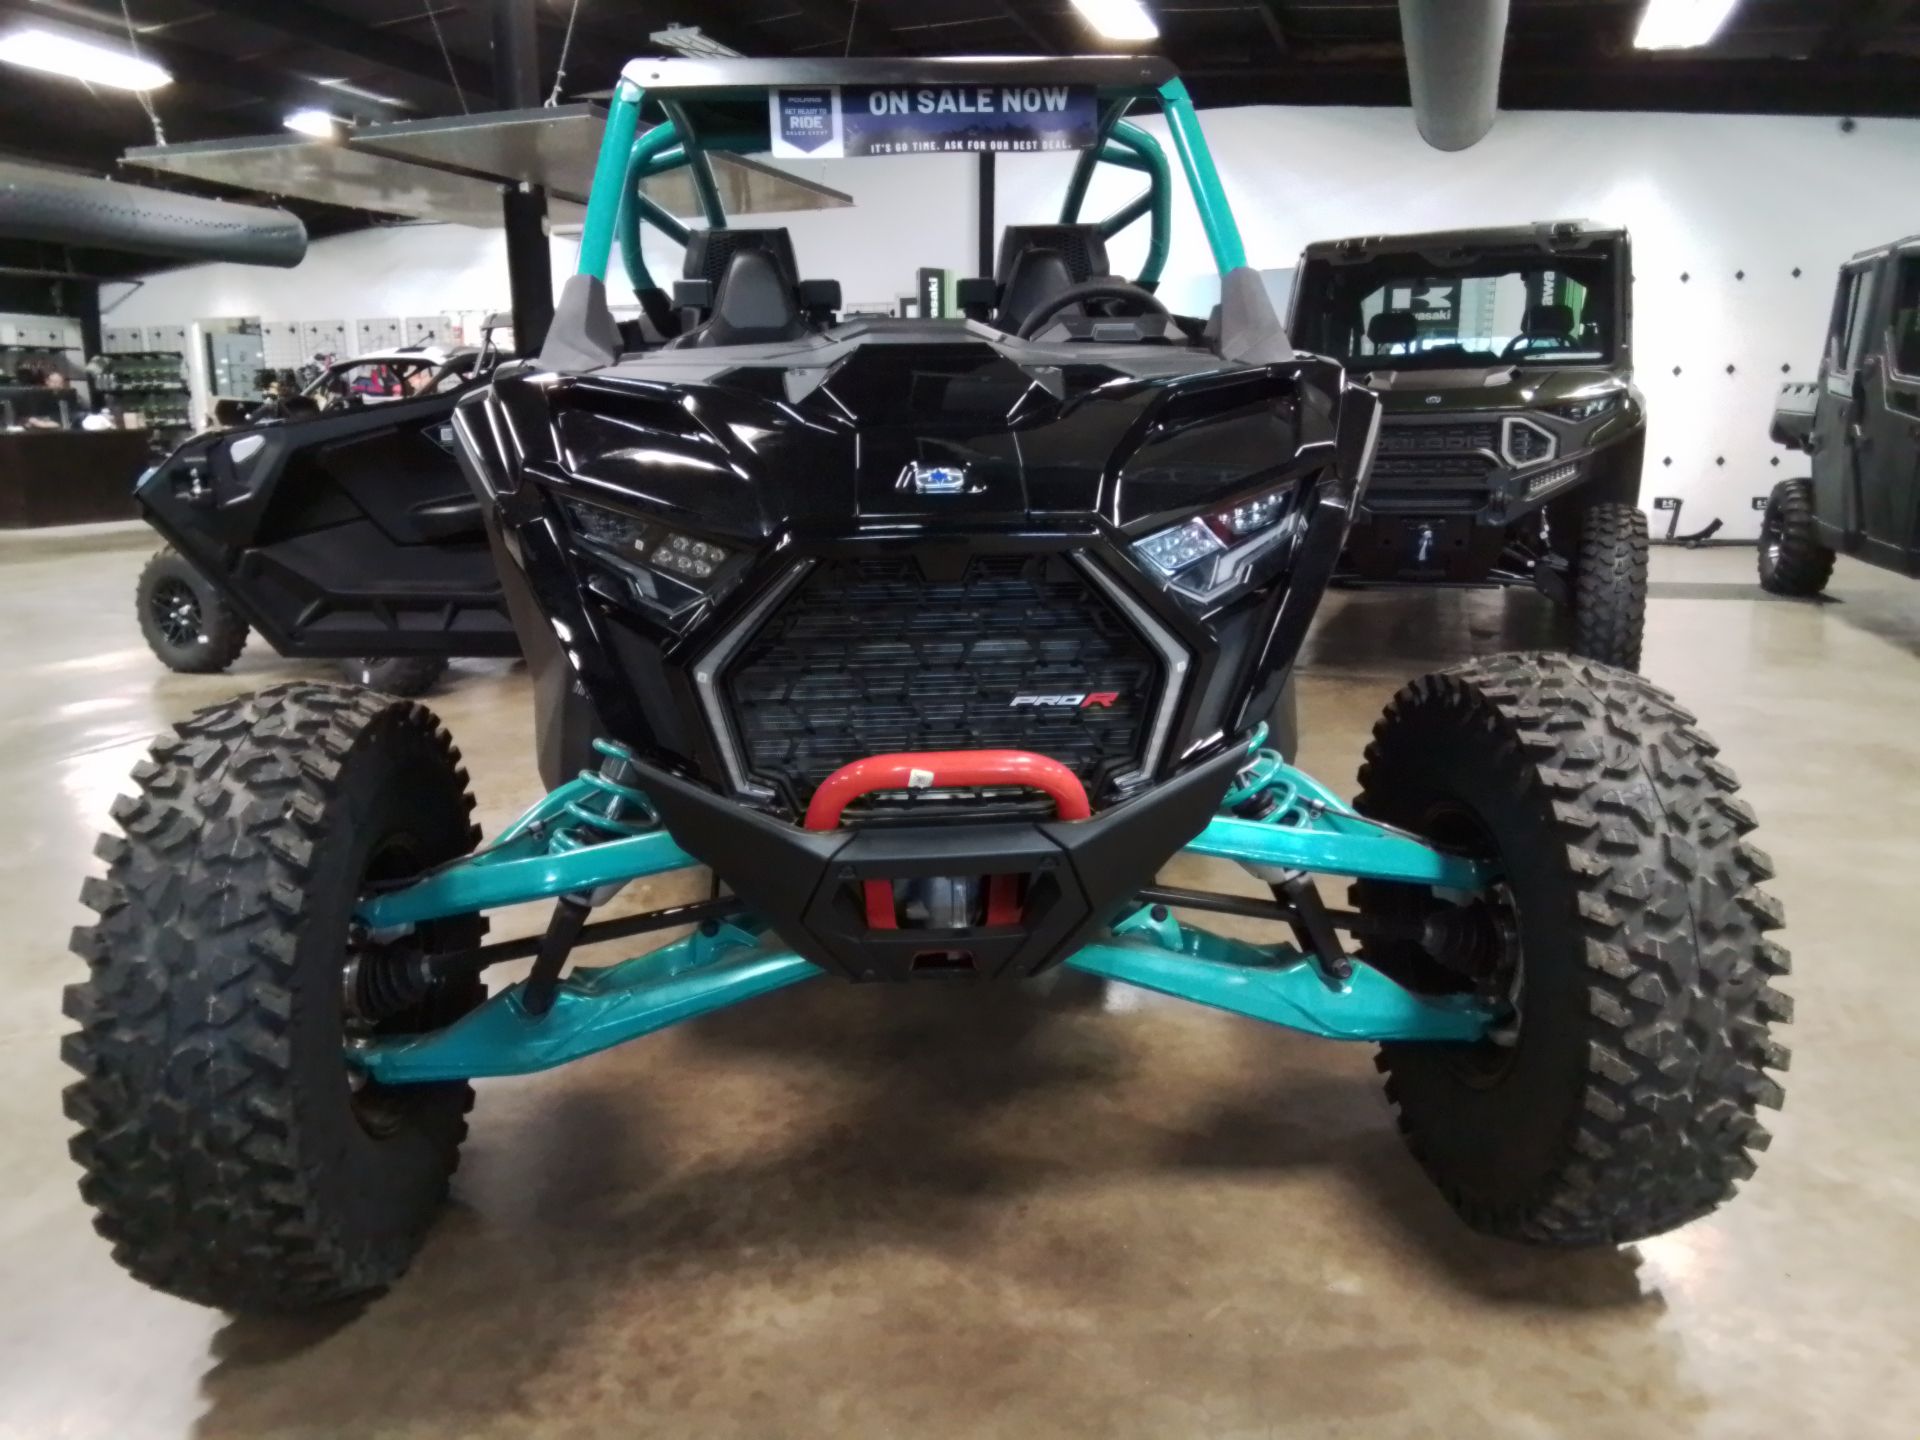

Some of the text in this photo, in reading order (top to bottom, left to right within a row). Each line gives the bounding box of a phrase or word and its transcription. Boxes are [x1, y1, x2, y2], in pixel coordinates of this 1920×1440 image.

[869, 86, 1069, 116] ON SALE NOW
[790, 116, 823, 129] RIDE
[871, 143, 892, 154] IT'S
[895, 142, 908, 153] GO
[912, 141, 940, 151] TIME.
[944, 140, 963, 150] ASK
[967, 140, 986, 150] FOR
[990, 140, 1009, 150] OUR
[1013, 140, 1038, 150] BEST
[928, 277, 939, 318] asaki
